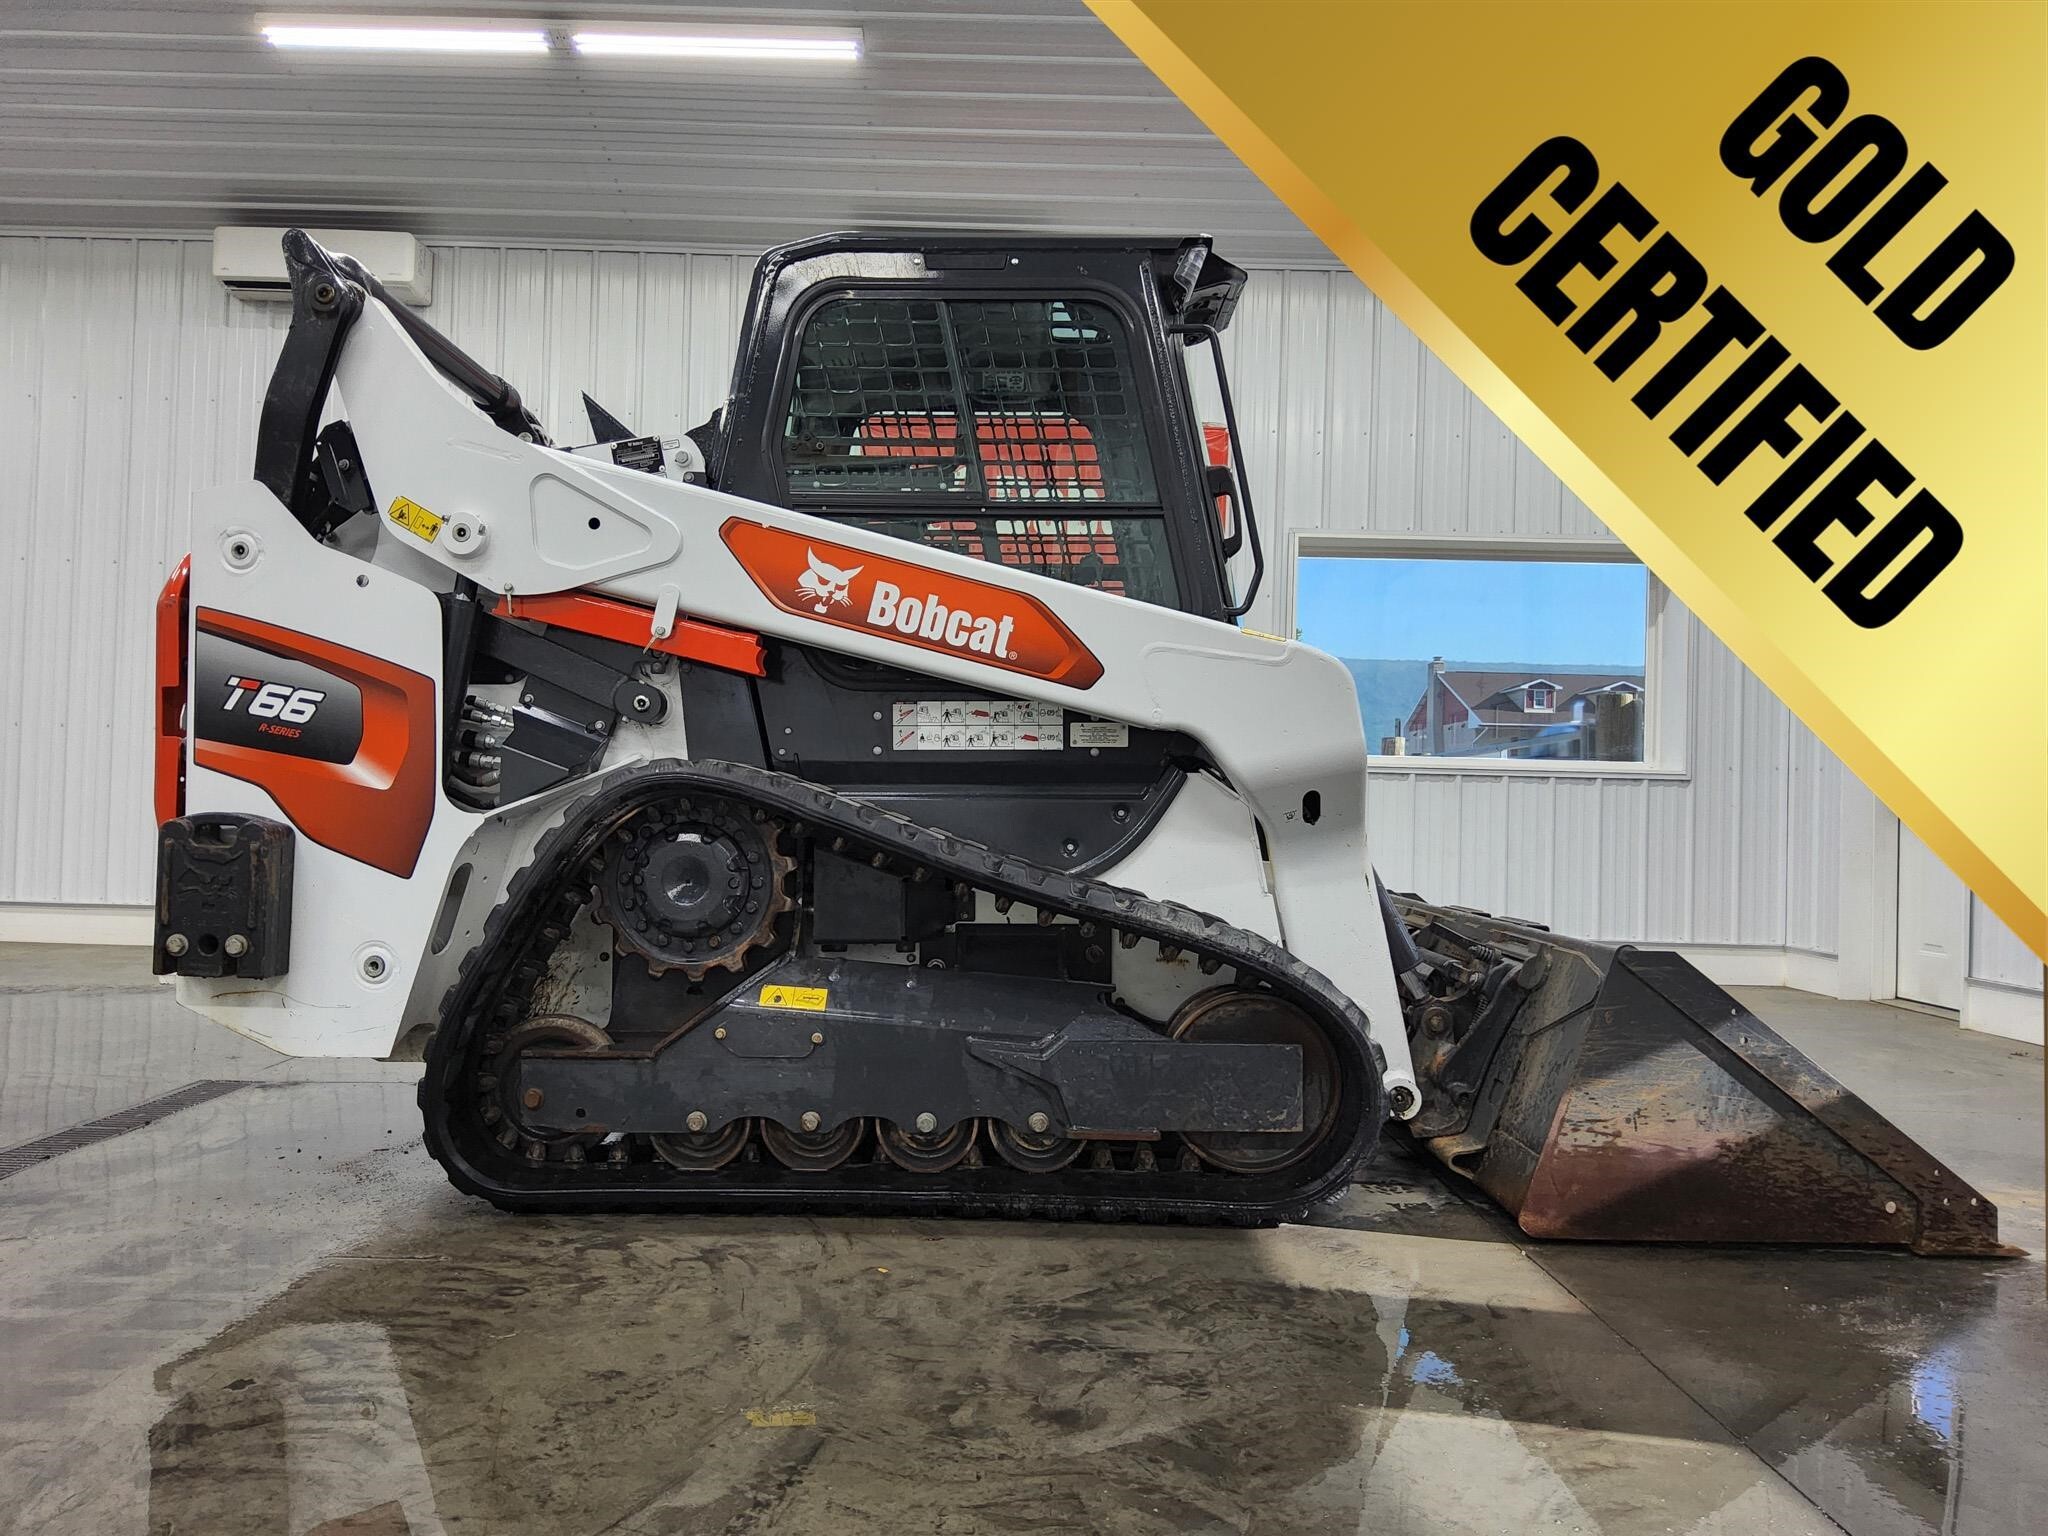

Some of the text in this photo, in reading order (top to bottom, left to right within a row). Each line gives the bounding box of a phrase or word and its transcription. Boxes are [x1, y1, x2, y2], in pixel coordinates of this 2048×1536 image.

[866, 580, 1014, 659] Bobcat
[223, 676, 325, 724] T66
[258, 723, 302, 738] R-SERIES
